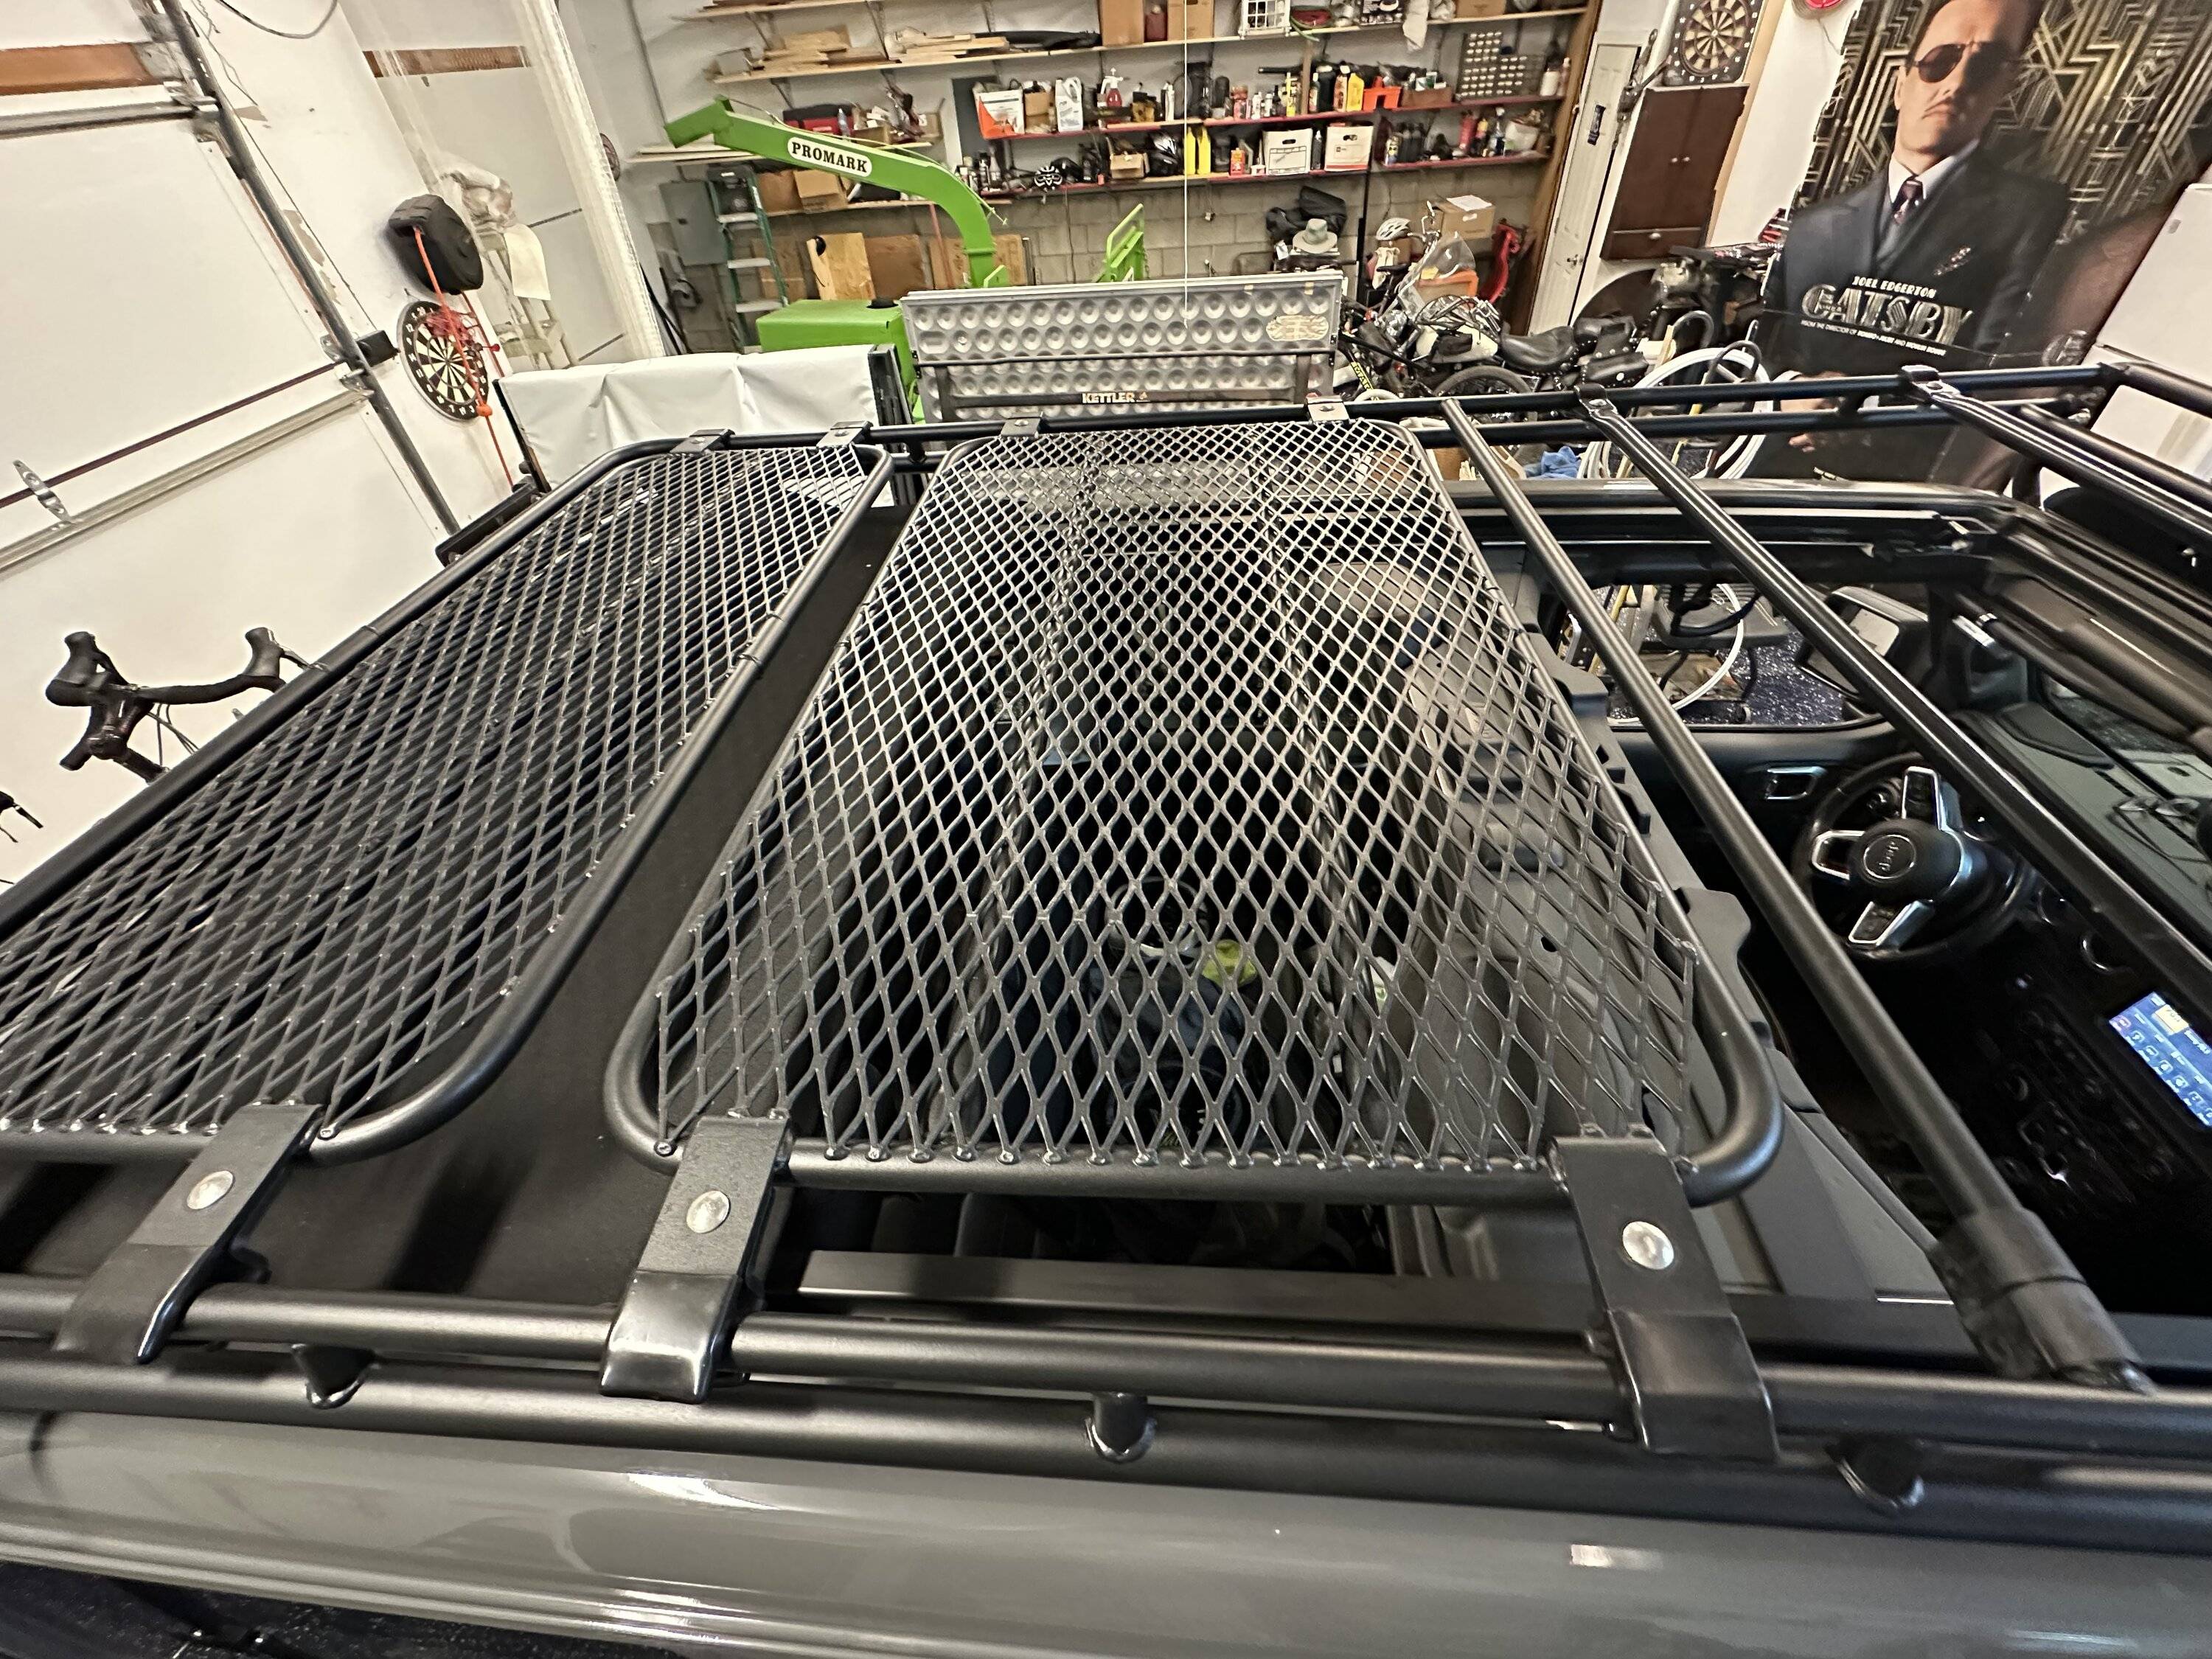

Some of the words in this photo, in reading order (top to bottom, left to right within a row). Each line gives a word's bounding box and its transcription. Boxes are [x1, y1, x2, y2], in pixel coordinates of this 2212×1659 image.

[791, 142, 868, 173] PROMARK
[1851, 276, 1879, 288] JOEL
[1879, 280, 1937, 299] EDGERTON
[1801, 282, 1975, 347] GATSBY
[1082, 392, 1136, 404] KETTLER
[1878, 841, 1900, 873] Jeep
